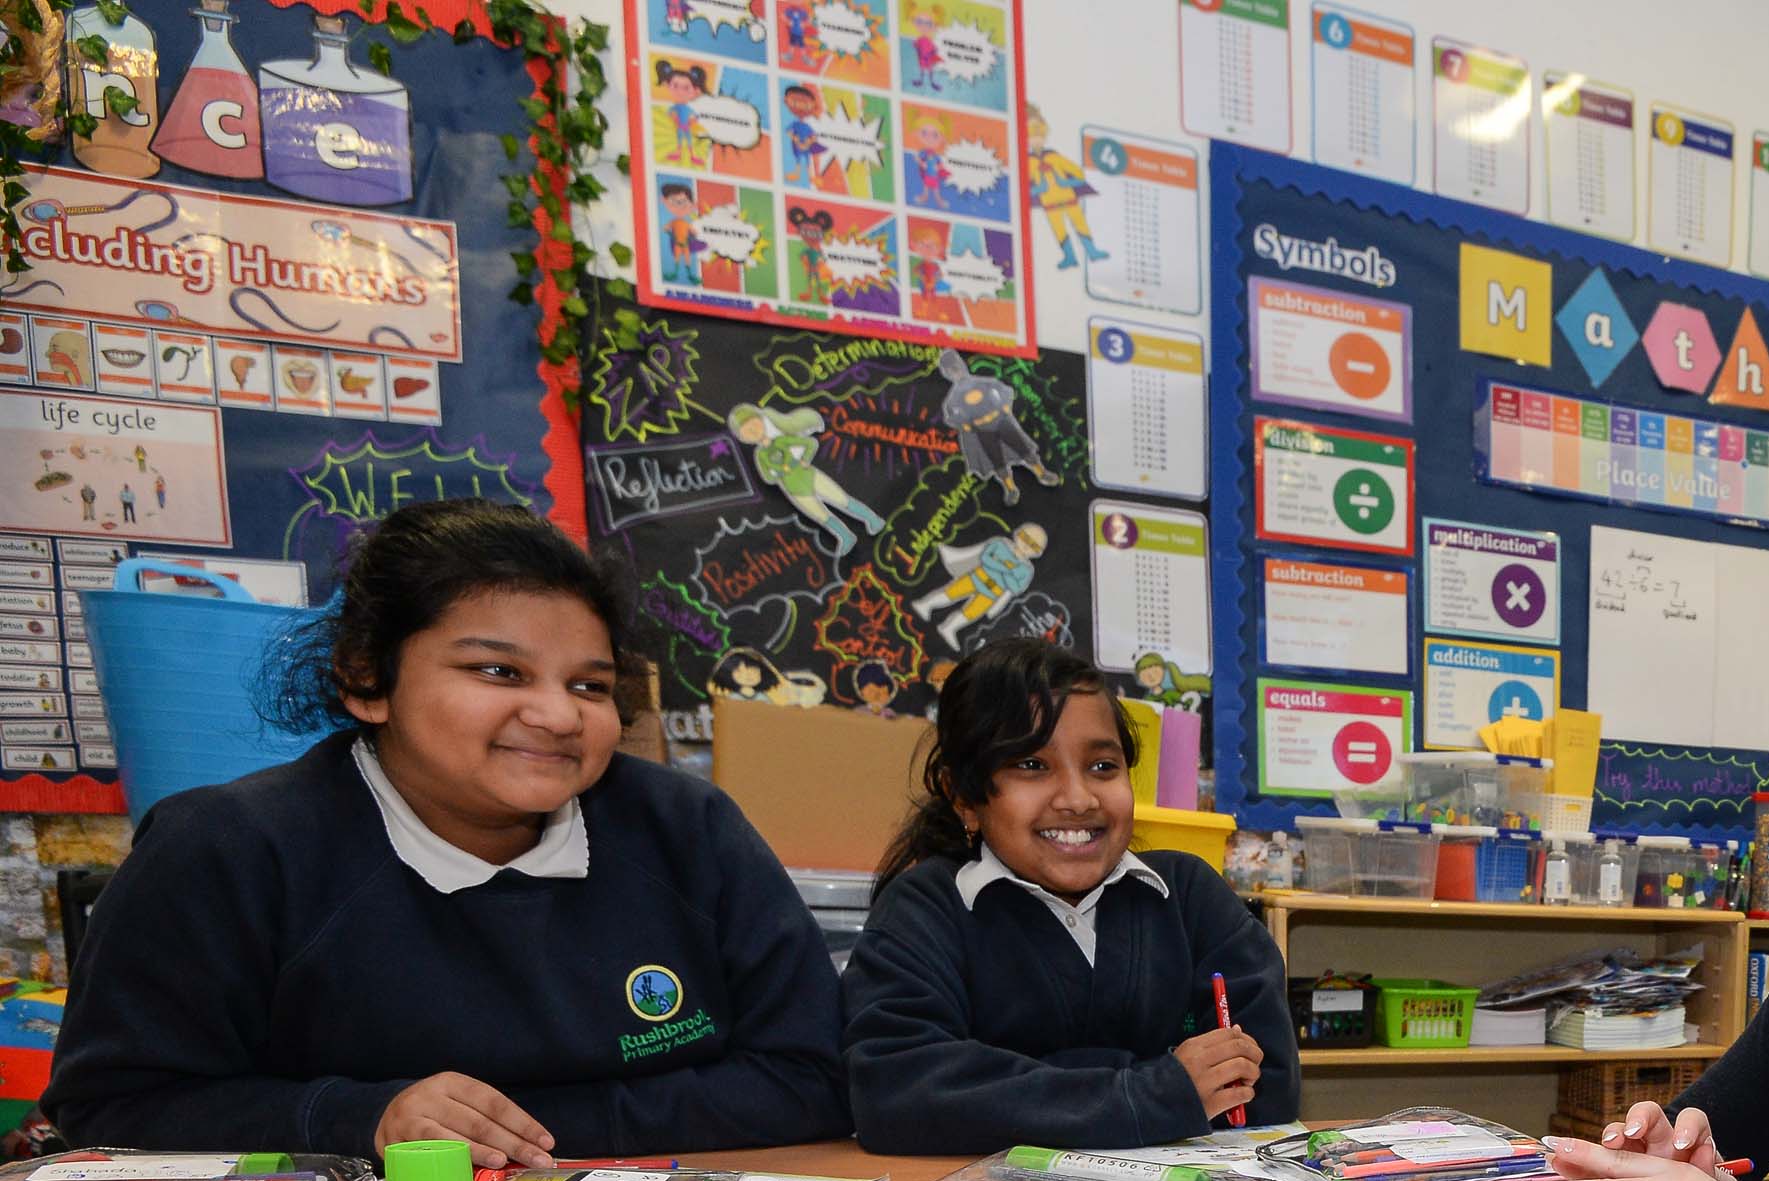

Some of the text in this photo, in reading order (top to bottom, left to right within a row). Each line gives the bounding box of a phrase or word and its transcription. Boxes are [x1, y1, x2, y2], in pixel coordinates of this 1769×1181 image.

[1329, 21, 1344, 42] 6
[1448, 54, 1461, 77] 7
[1665, 118, 1676, 140] 9
[1101, 144, 1119, 169] 4
[1257, 226, 1393, 283] Symbols
[231, 242, 427, 305] Humans
[1265, 292, 1367, 324] subtraction
[1107, 333, 1125, 358] 3
[42, 401, 157, 438] life cycle
[832, 405, 961, 453] Communication
[1269, 430, 1335, 454] division
[604, 454, 735, 512] Reflection
[1596, 460, 1731, 500] Place Value
[1111, 516, 1129, 544] 2
[1433, 528, 1537, 556] multiplication
[703, 528, 825, 604] Positivity
[1271, 566, 1365, 588] subtraction
[1433, 648, 1500, 669] addition
[1270, 691, 1326, 709] equals
[1600, 753, 1751, 800] Try this method
[1750, 958, 1759, 997] OXFORD
[623, 1037, 672, 1062] Primary
[1063, 1153, 1139, 1170] KF10506
